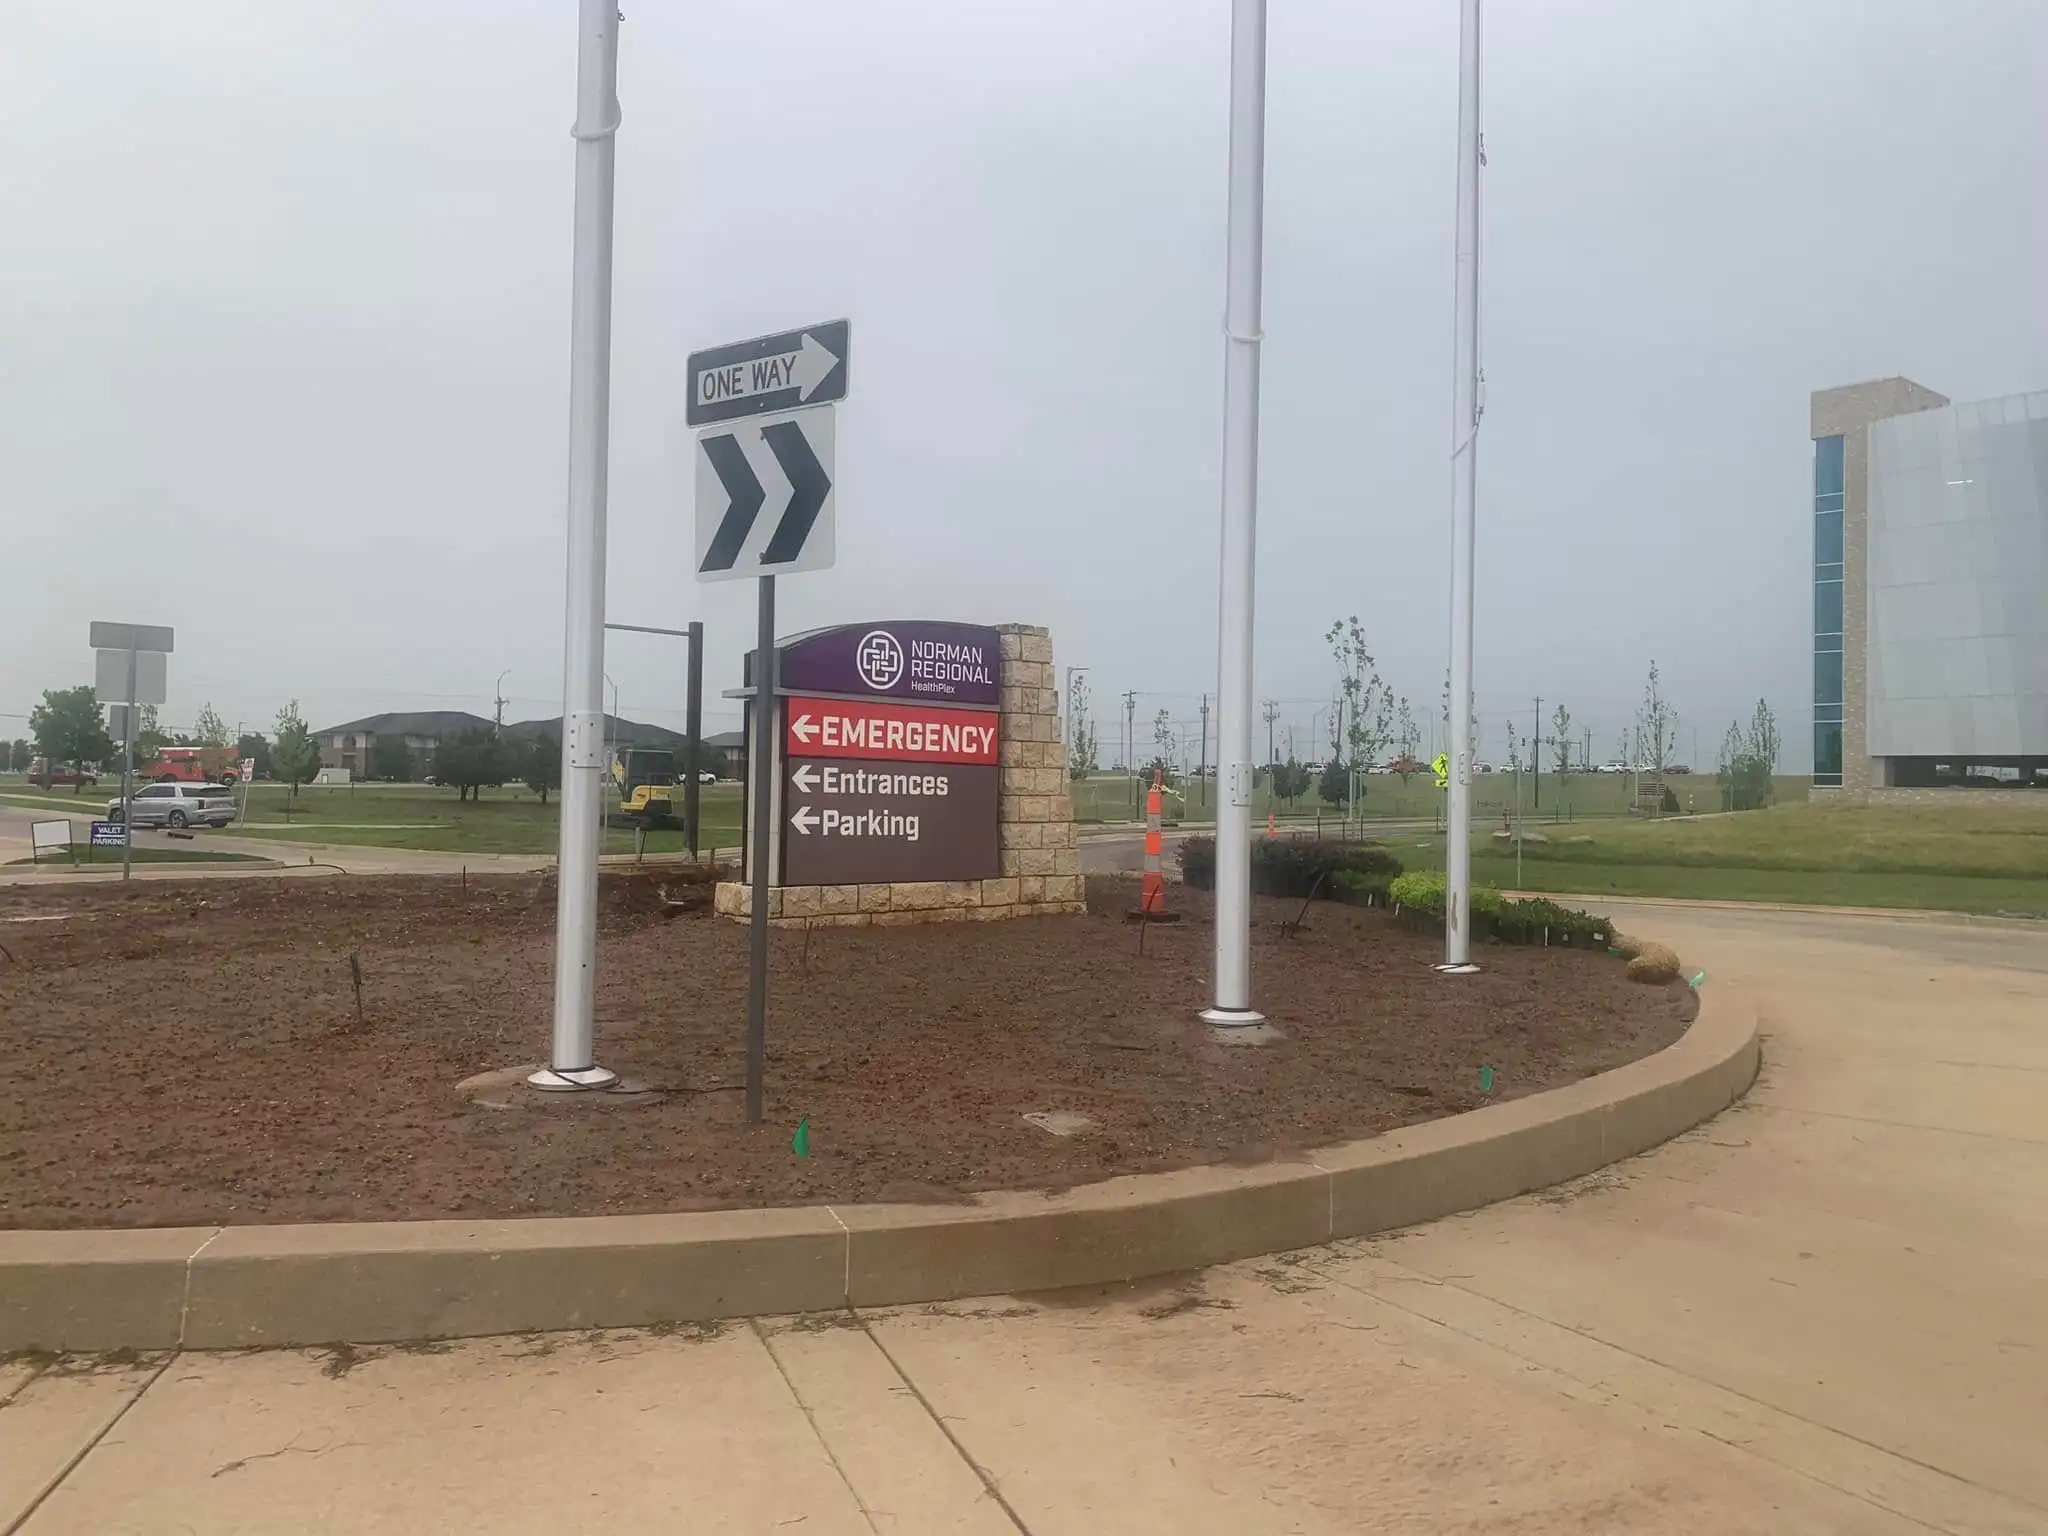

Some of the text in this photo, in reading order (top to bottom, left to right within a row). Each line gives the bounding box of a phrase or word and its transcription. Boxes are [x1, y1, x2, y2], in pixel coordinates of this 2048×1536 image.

[703, 354, 797, 401] ONE WAY
[911, 639, 983, 665] NORMAN
[911, 659, 993, 684] REGIONAL
[911, 680, 956, 694] HealthPlex
[822, 715, 995, 754] EMERGENCY
[823, 767, 949, 796] Entrances
[98, 826, 123, 834] VALET
[822, 809, 919, 841] Parking
[92, 837, 126, 846] PARKING
